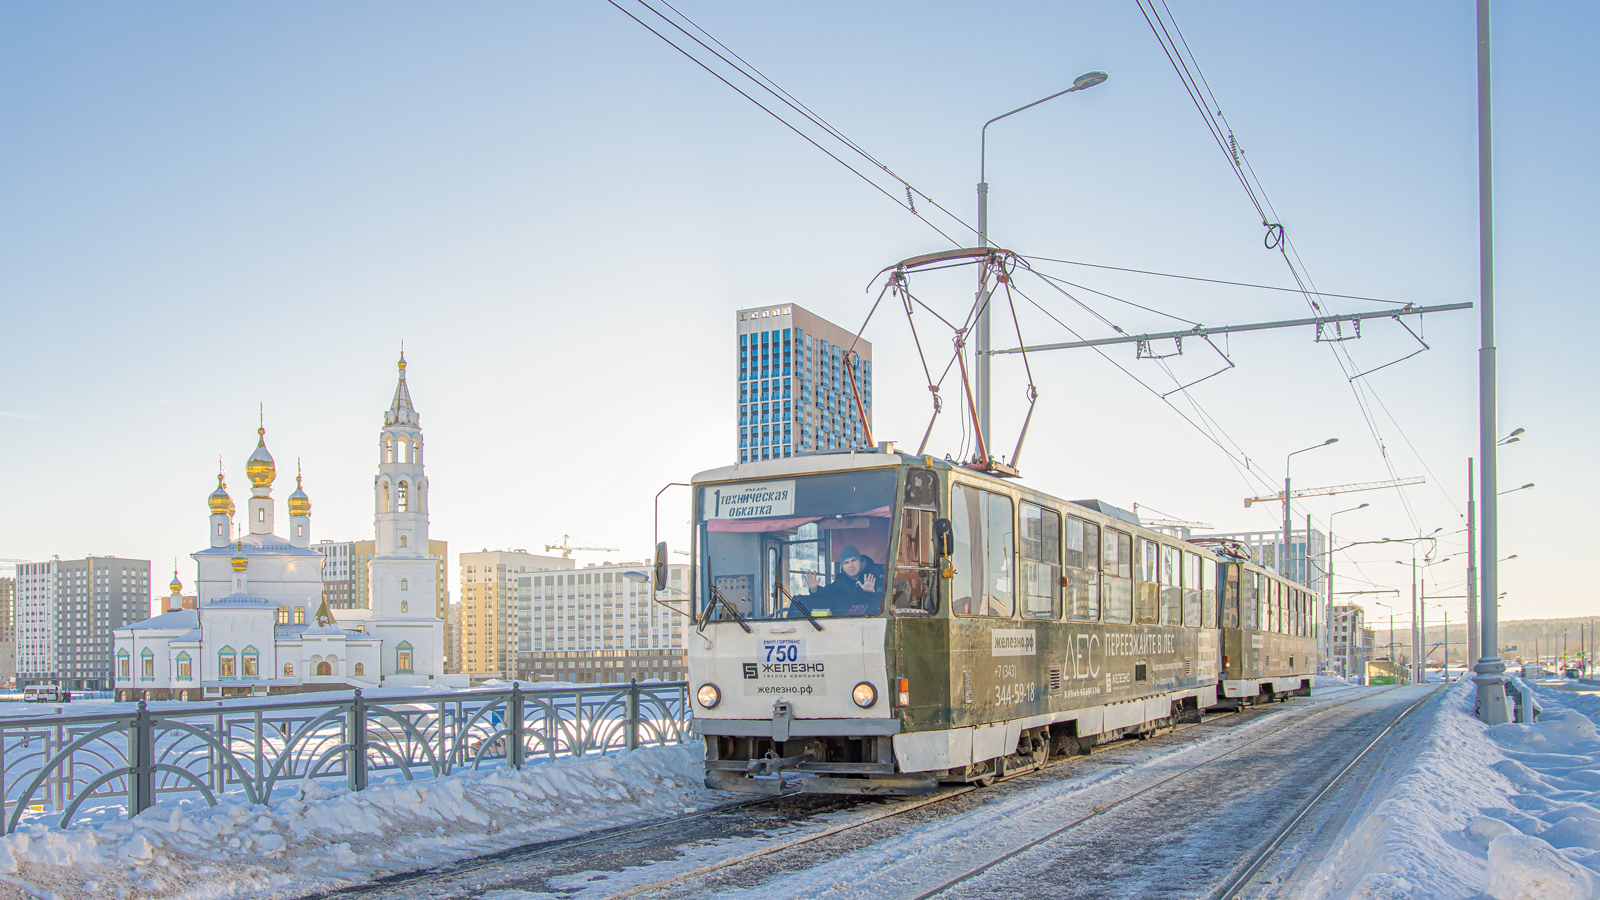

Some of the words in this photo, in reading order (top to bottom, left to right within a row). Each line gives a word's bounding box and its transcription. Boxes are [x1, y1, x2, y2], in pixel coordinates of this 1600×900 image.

[713, 489, 721, 517] 1
[994, 633, 1034, 652] железно.рф
[1105, 629, 1156, 656] ПЕРЕЕЗЖАЙТЕ
[1157, 633, 1162, 654] В
[1163, 633, 1175, 654] ЛЕС
[764, 644, 798, 662] 750
[1063, 633, 1100, 680] ЛЕС
[762, 663, 825, 673] ЖЕЛЕЗНО
[994, 665, 1002, 678] +7
[1002, 664, 1017, 680] (343)
[757, 684, 814, 696] железно.рф
[995, 682, 1035, 706] 344-59-18
